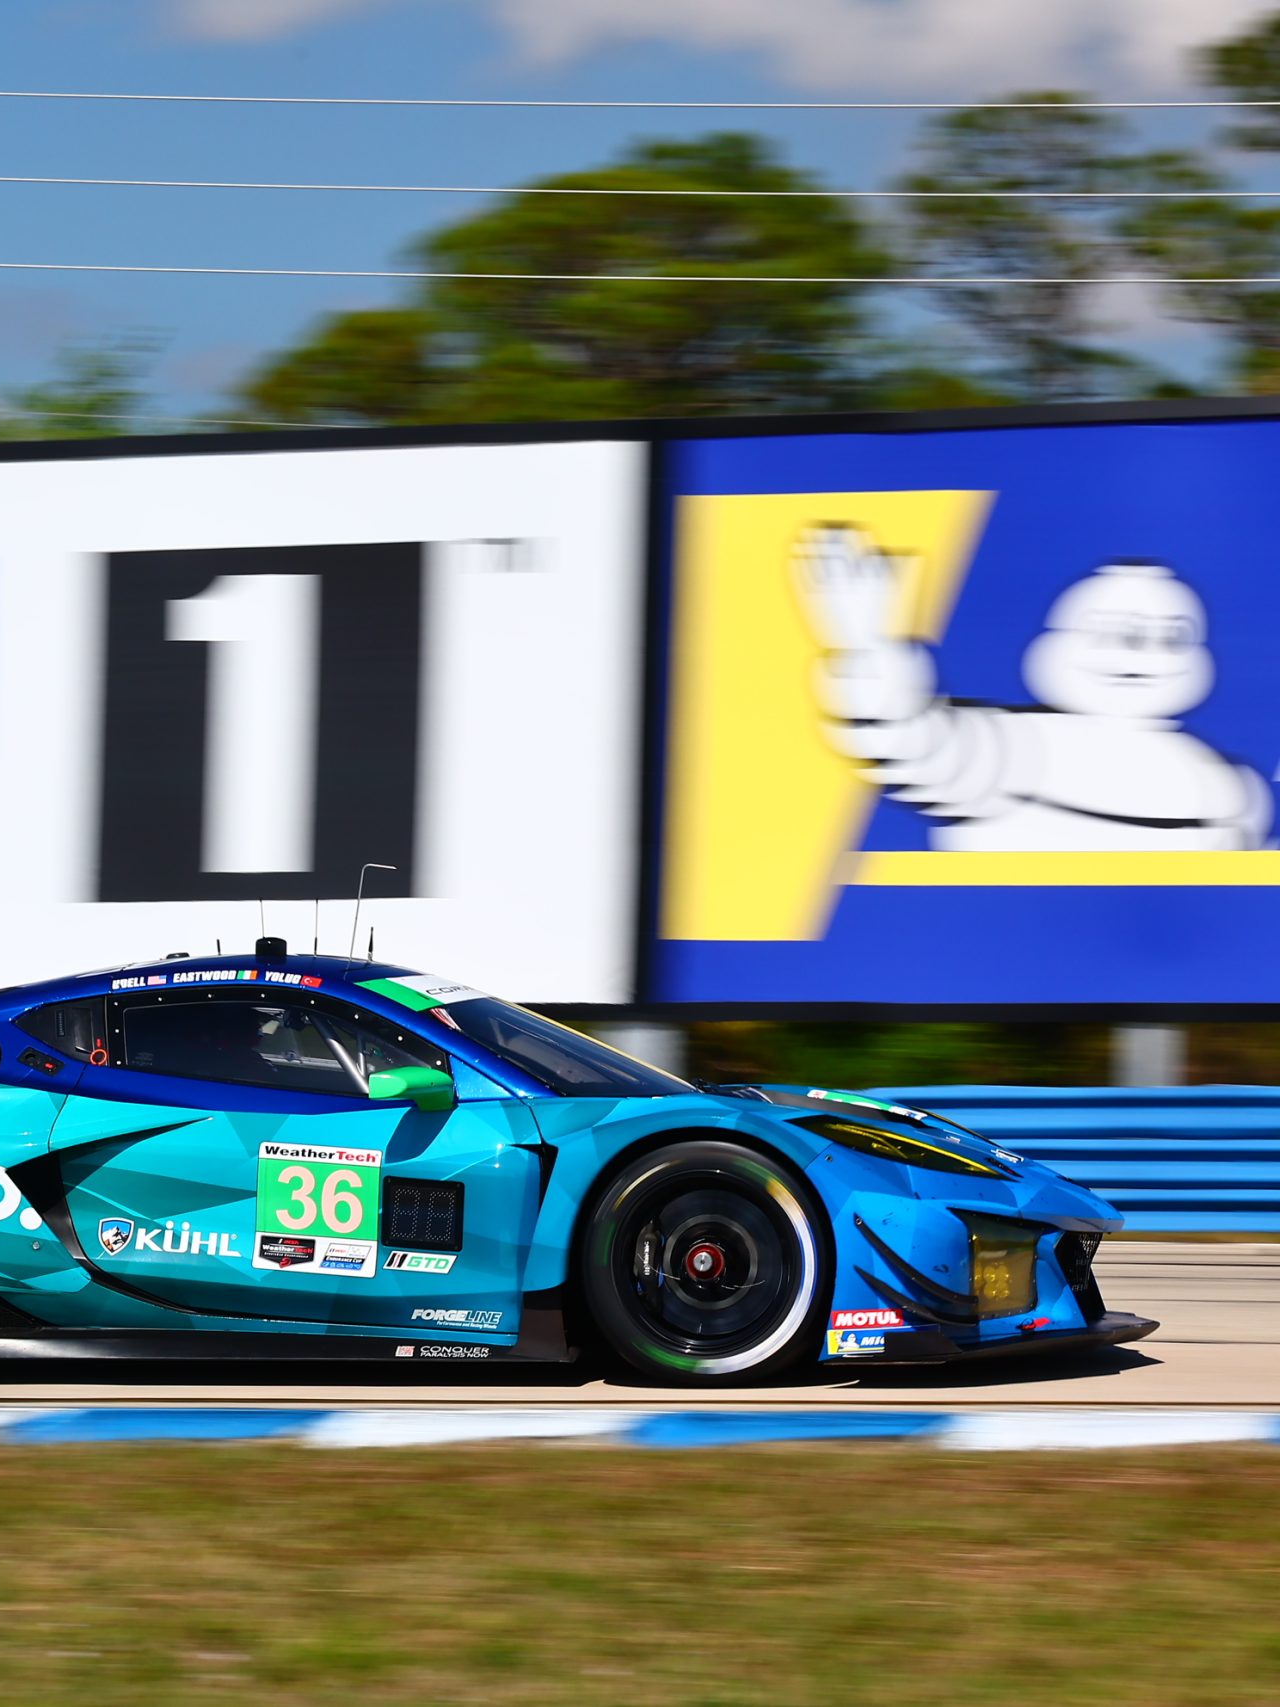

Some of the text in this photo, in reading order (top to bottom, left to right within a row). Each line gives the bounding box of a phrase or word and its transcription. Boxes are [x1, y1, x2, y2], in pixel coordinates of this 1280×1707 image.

[163, 573, 322, 873] 1
[173, 970, 236, 983] EASTWOOD
[265, 1145, 377, 1163] WeatherTech
[275, 1165, 364, 1234] 36
[134, 1220, 242, 1257] KÜHL
[407, 1256, 450, 1270] GTD
[411, 1309, 502, 1324] FORGELINE
[835, 1312, 901, 1327] MOTUL
[420, 1346, 490, 1354] CONQUER
